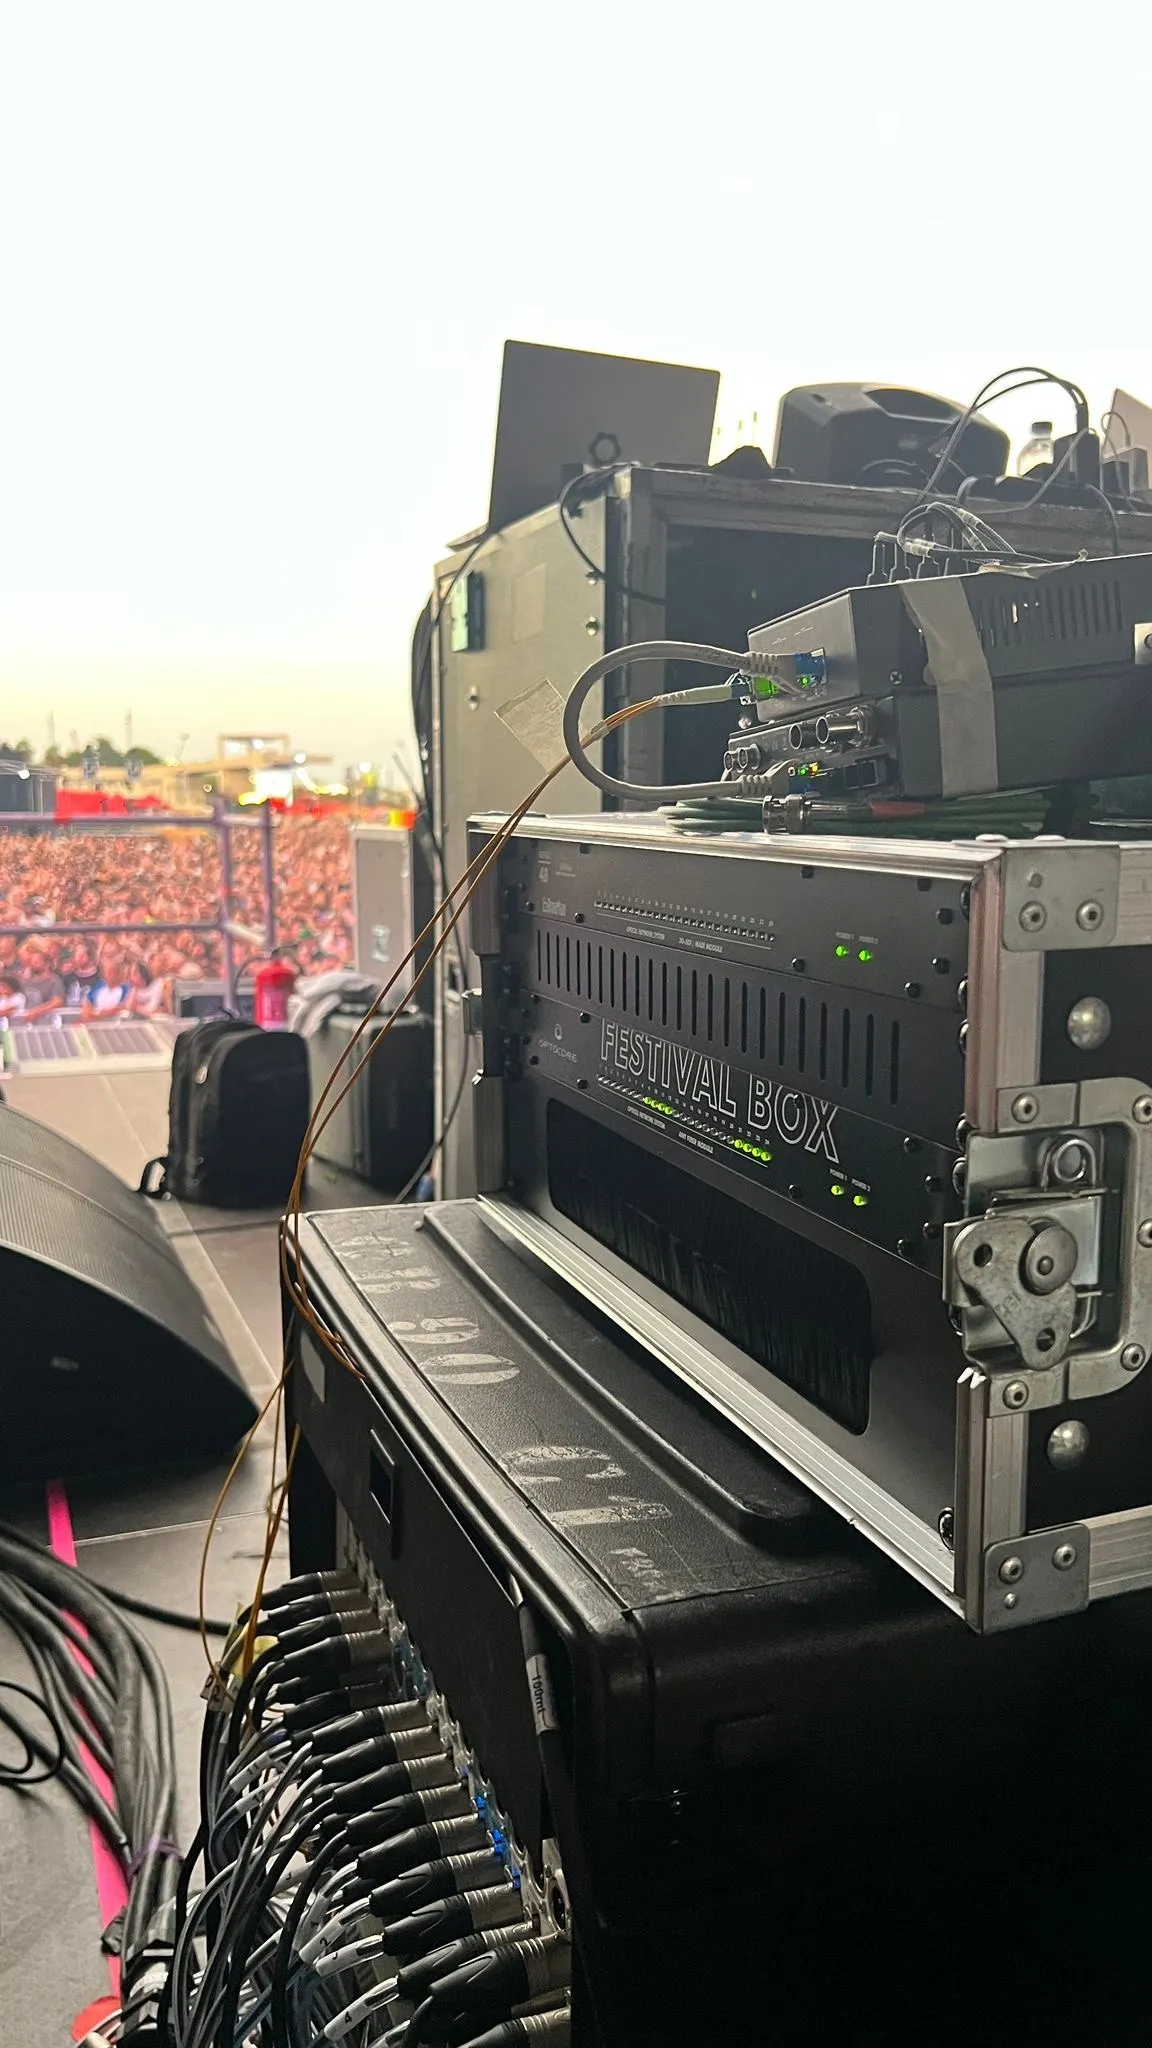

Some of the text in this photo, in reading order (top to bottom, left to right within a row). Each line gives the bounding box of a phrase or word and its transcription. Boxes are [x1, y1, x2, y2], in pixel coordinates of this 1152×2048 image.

[601, 1018, 840, 1164] FESTIVAL BOX
[344, 2010, 353, 2024] 4
